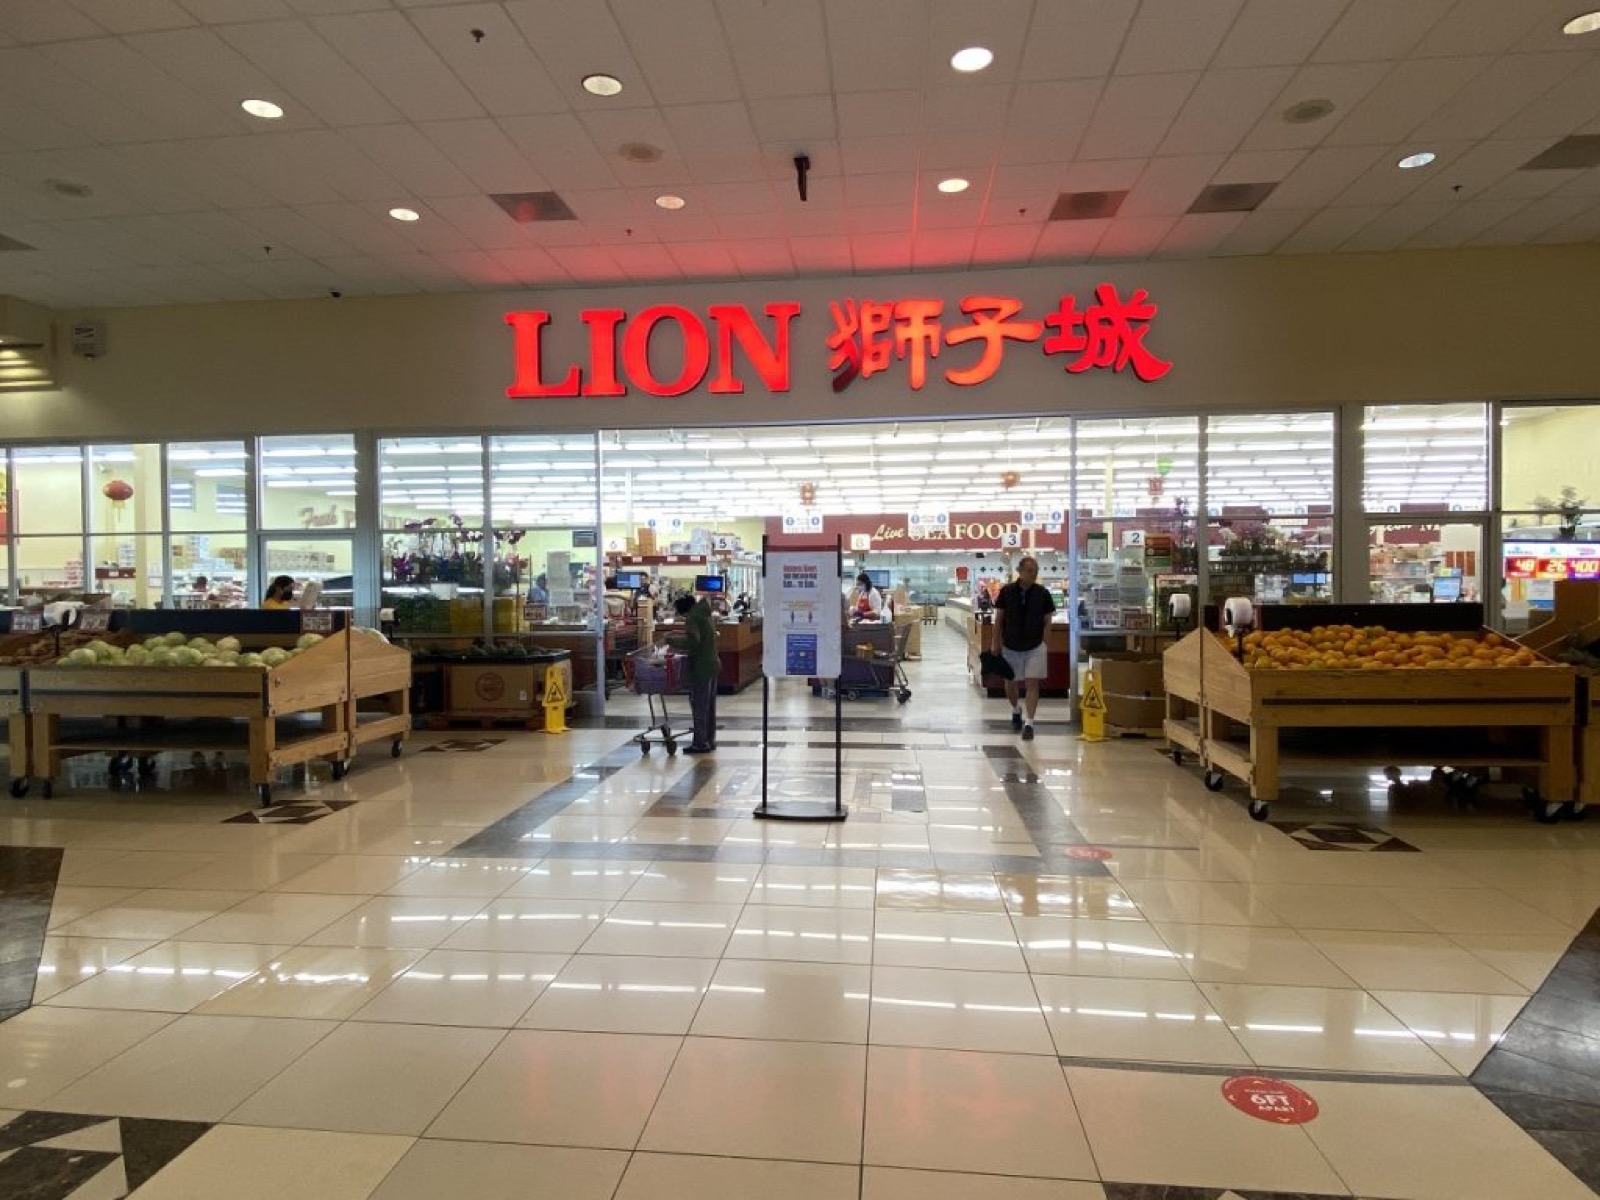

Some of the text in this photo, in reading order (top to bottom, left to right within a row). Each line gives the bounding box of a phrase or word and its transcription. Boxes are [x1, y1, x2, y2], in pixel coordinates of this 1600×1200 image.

[505, 283, 1173, 398] LION 獅子城
[872, 522, 1021, 541] Live EAFOOD
[719, 538, 727, 548] 5
[1008, 534, 1017, 545] 3
[1132, 532, 1140, 543] 2
[1547, 560, 1567, 573] 26
[1251, 1095, 1290, 1106] 6FT
